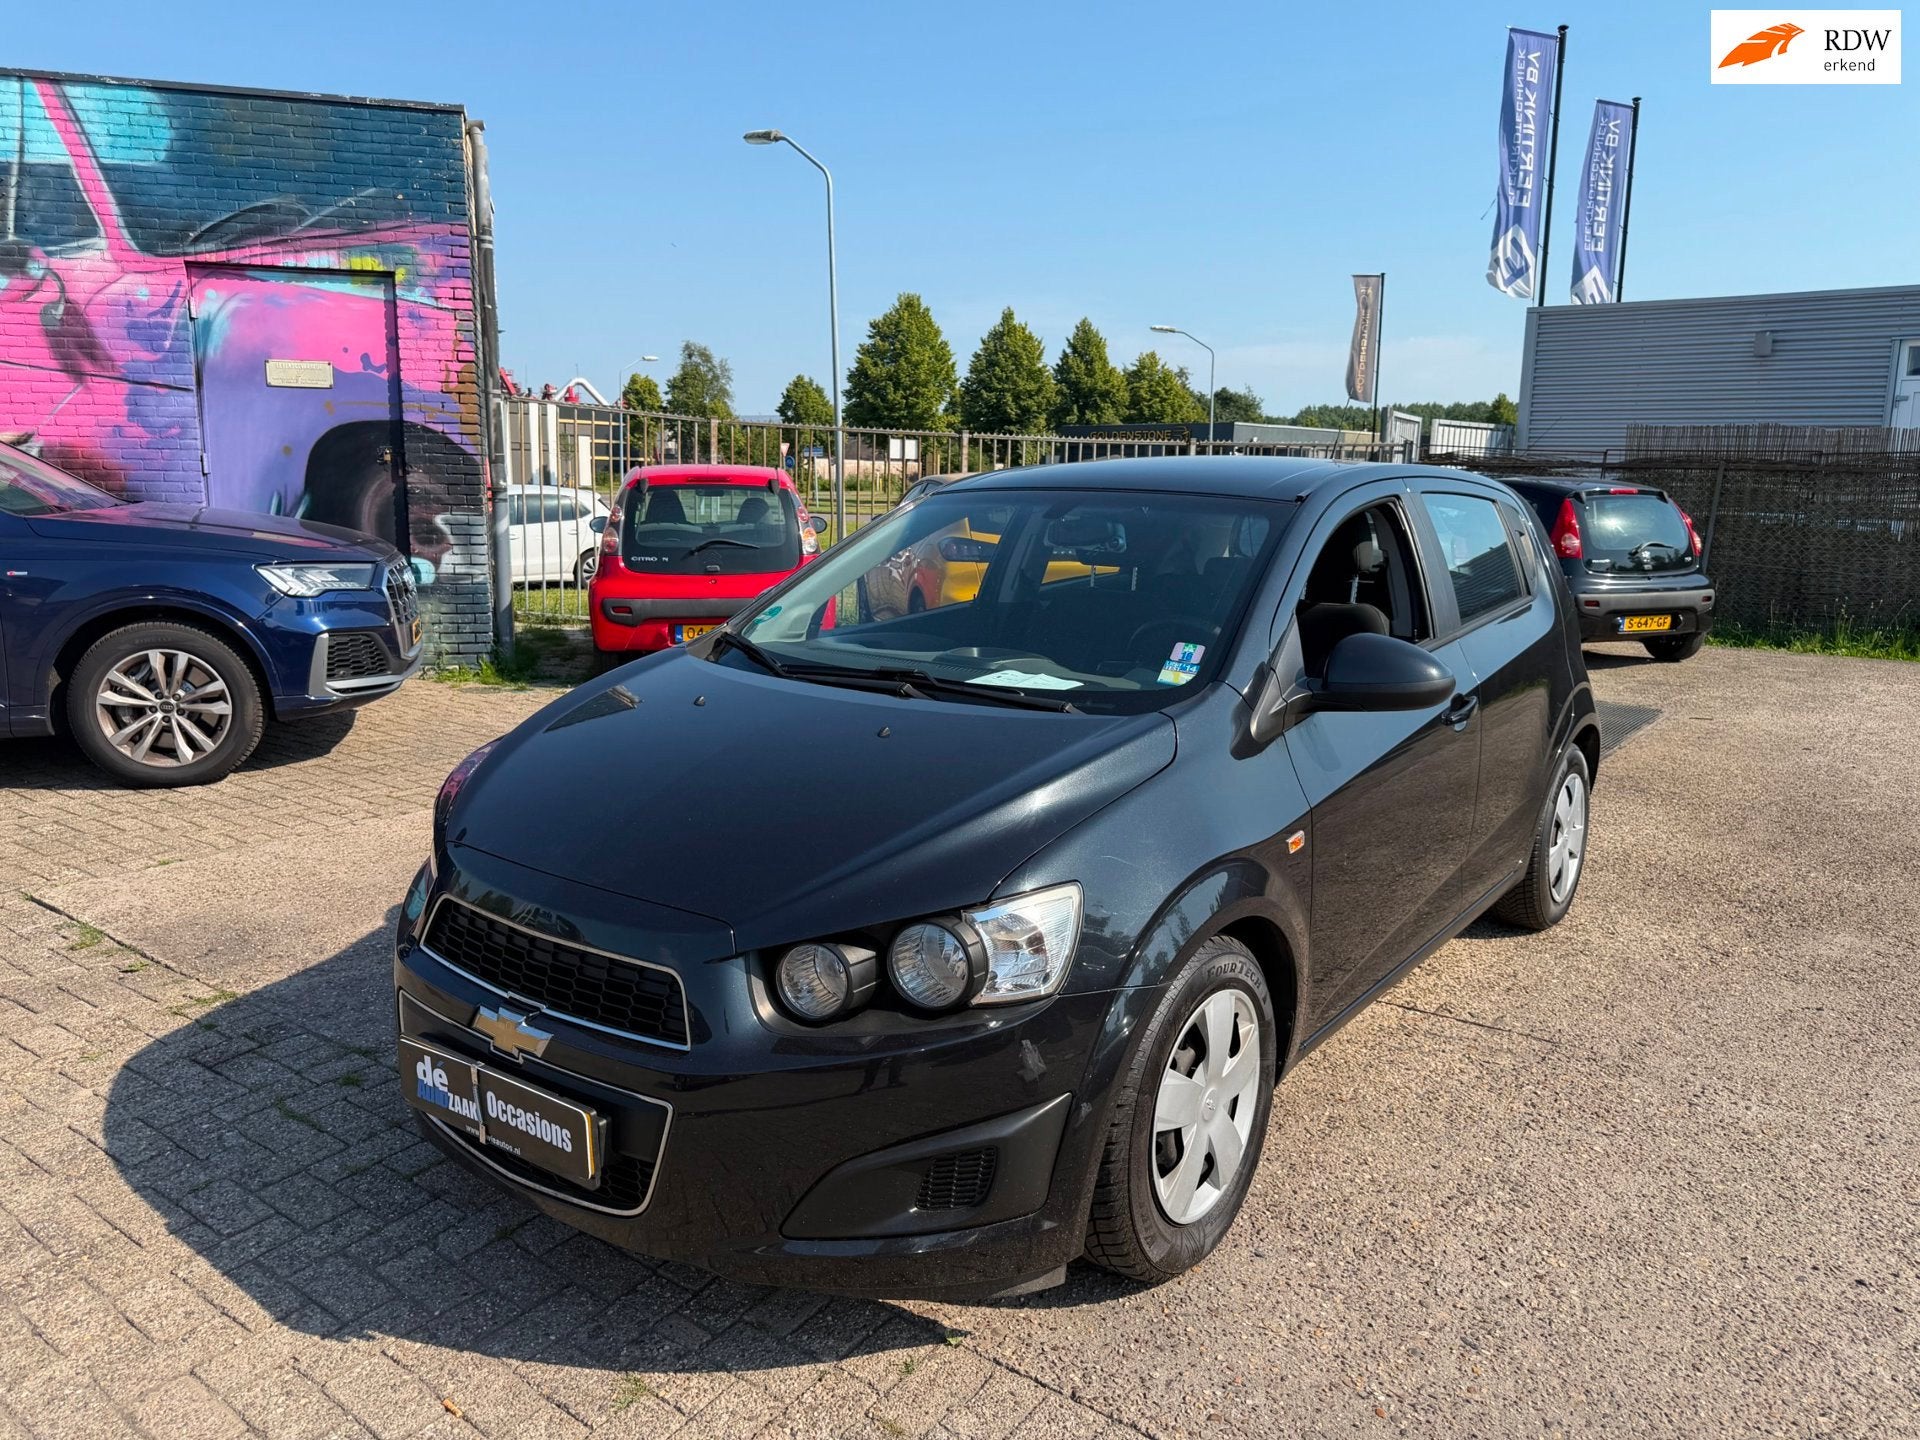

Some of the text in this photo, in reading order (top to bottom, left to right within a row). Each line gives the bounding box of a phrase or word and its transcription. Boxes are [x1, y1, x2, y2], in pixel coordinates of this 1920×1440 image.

[1089, 429, 1172, 440] GOLDENSTONE
[1627, 616, 1669, 629] S-647-GF
[486, 1090, 572, 1153] Occasions
